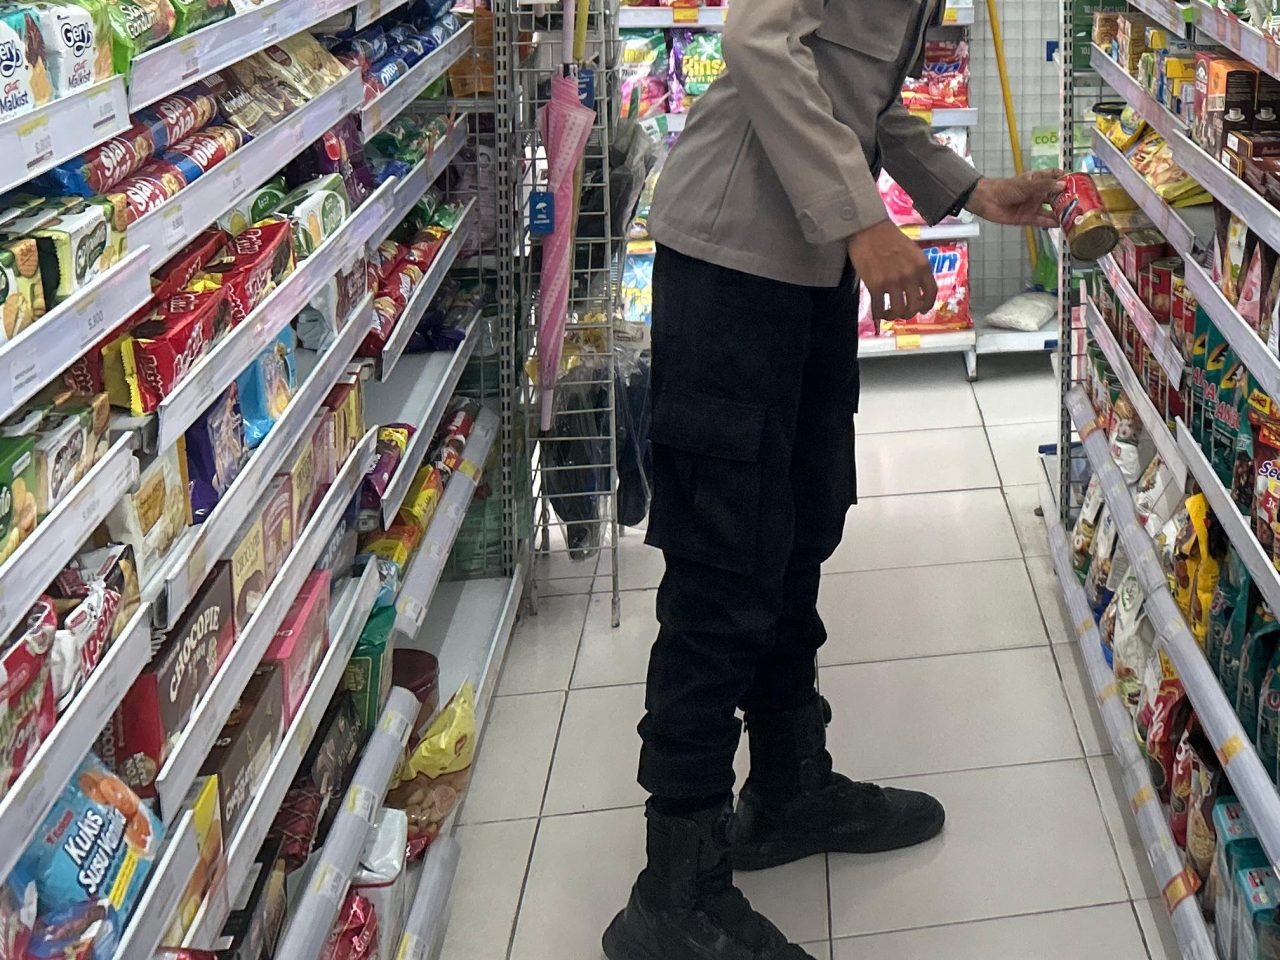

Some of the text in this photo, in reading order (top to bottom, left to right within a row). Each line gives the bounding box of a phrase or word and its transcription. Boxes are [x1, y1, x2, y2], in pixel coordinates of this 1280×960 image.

[0, 38, 24, 78] ery
[61, 21, 94, 58] Gery
[0, 91, 30, 114] Malkist
[928, 248, 960, 273] lin
[63, 809, 106, 865] Kukis
